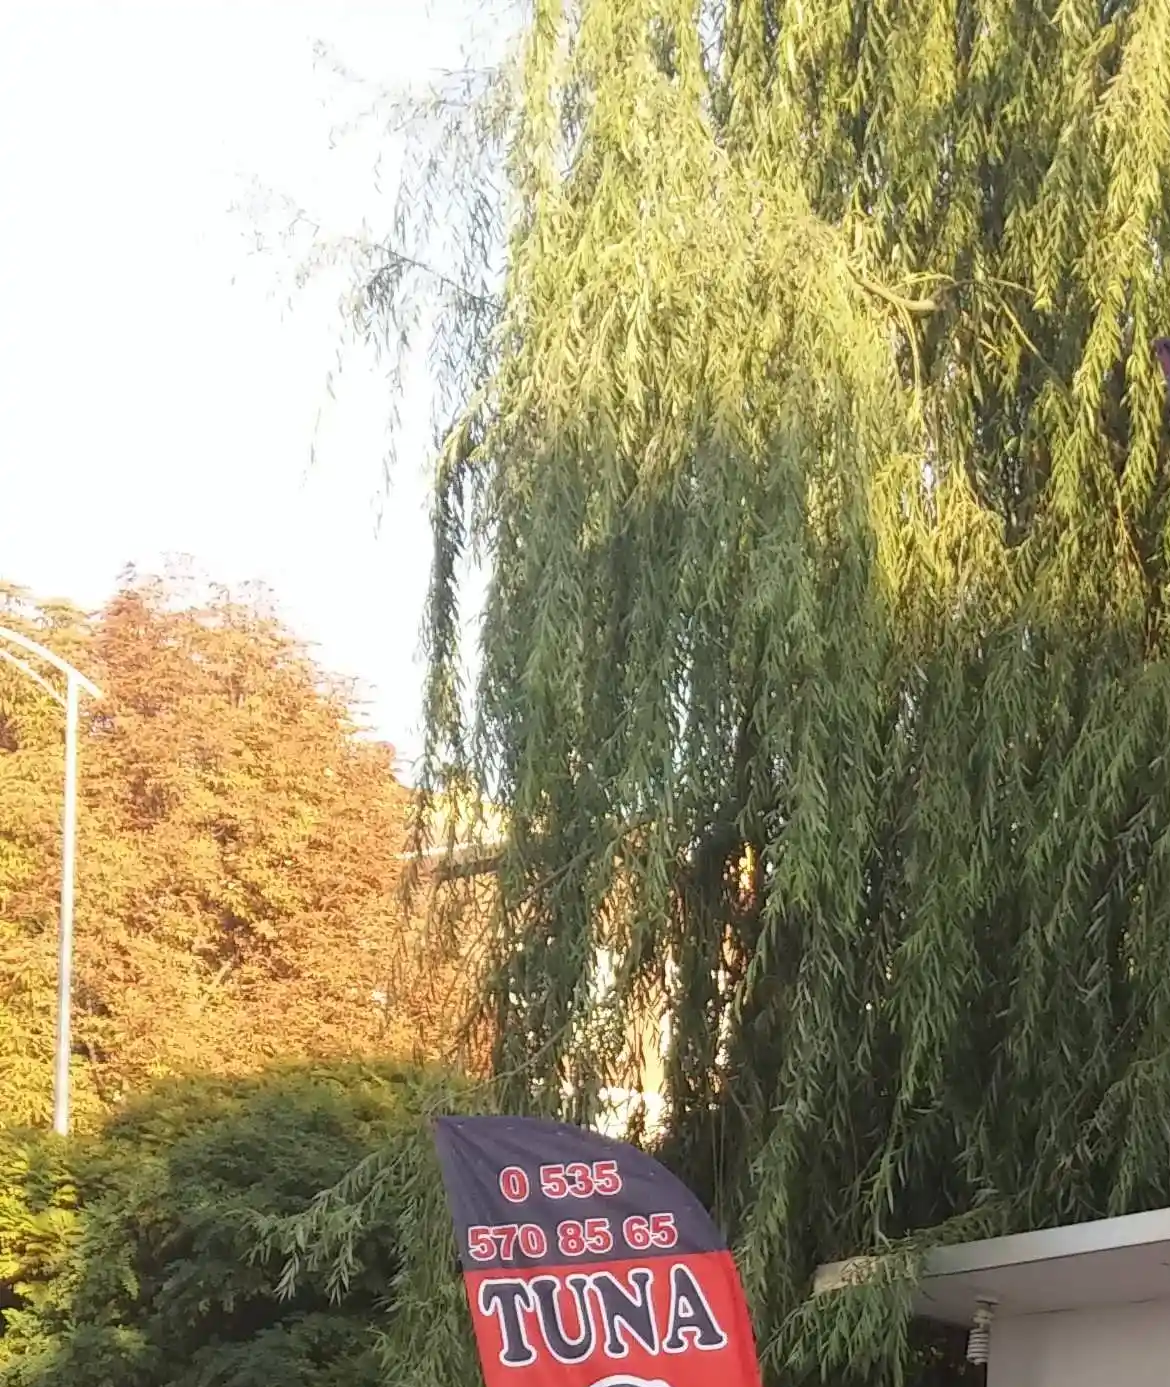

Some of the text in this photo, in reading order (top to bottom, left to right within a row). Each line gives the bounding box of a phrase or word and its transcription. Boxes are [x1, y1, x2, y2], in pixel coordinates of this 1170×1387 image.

[500, 1160, 622, 1202] 0 535
[468, 1213, 678, 1261] 570 85 65
[478, 1263, 727, 1367] TUNA
